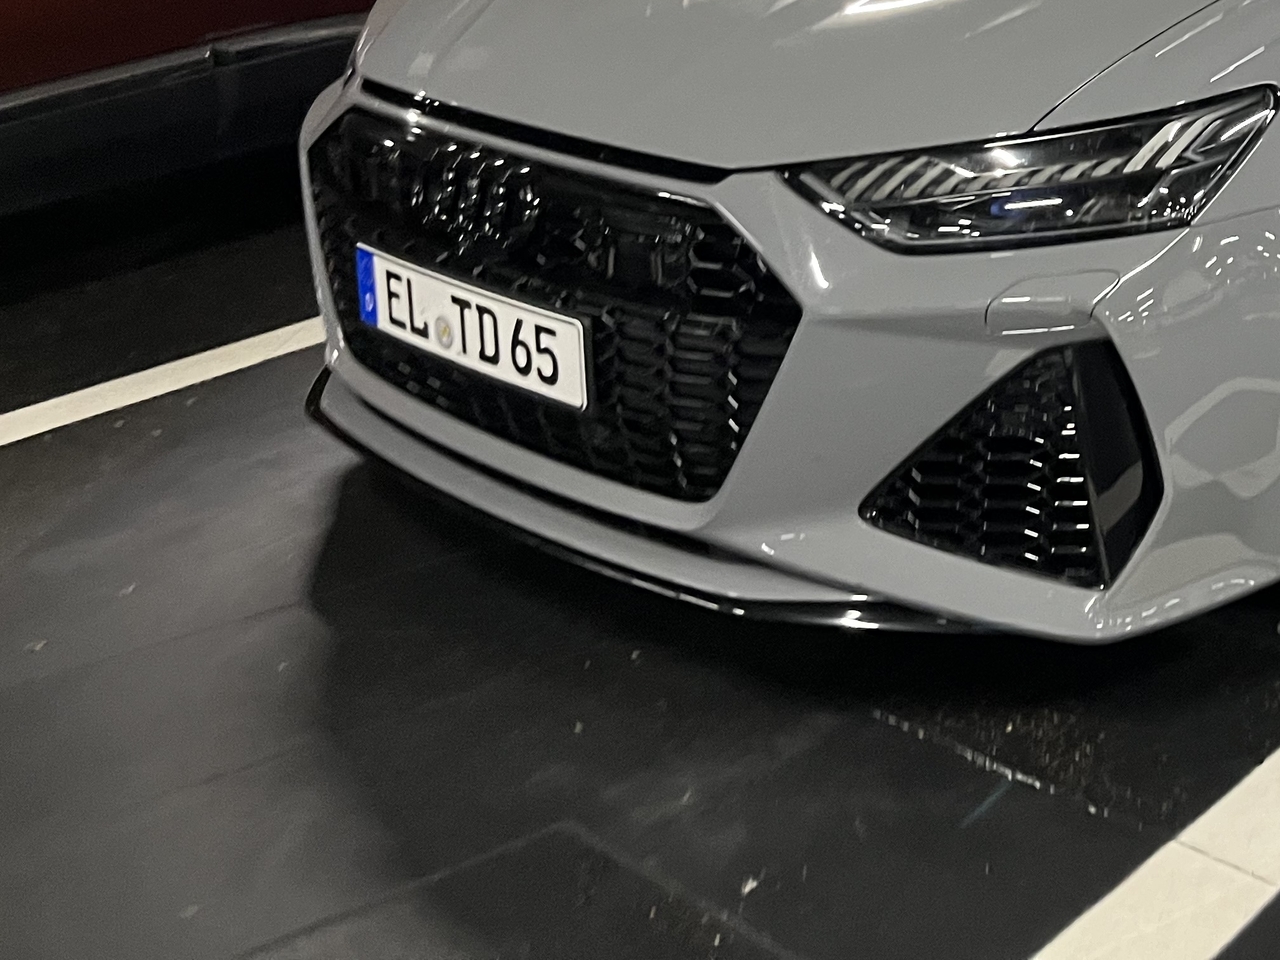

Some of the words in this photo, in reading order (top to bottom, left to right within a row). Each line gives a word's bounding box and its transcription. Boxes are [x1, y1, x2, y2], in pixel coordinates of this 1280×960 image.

[385, 269, 430, 340] EL
[450, 294, 500, 367] TD
[510, 317, 559, 386] 65
